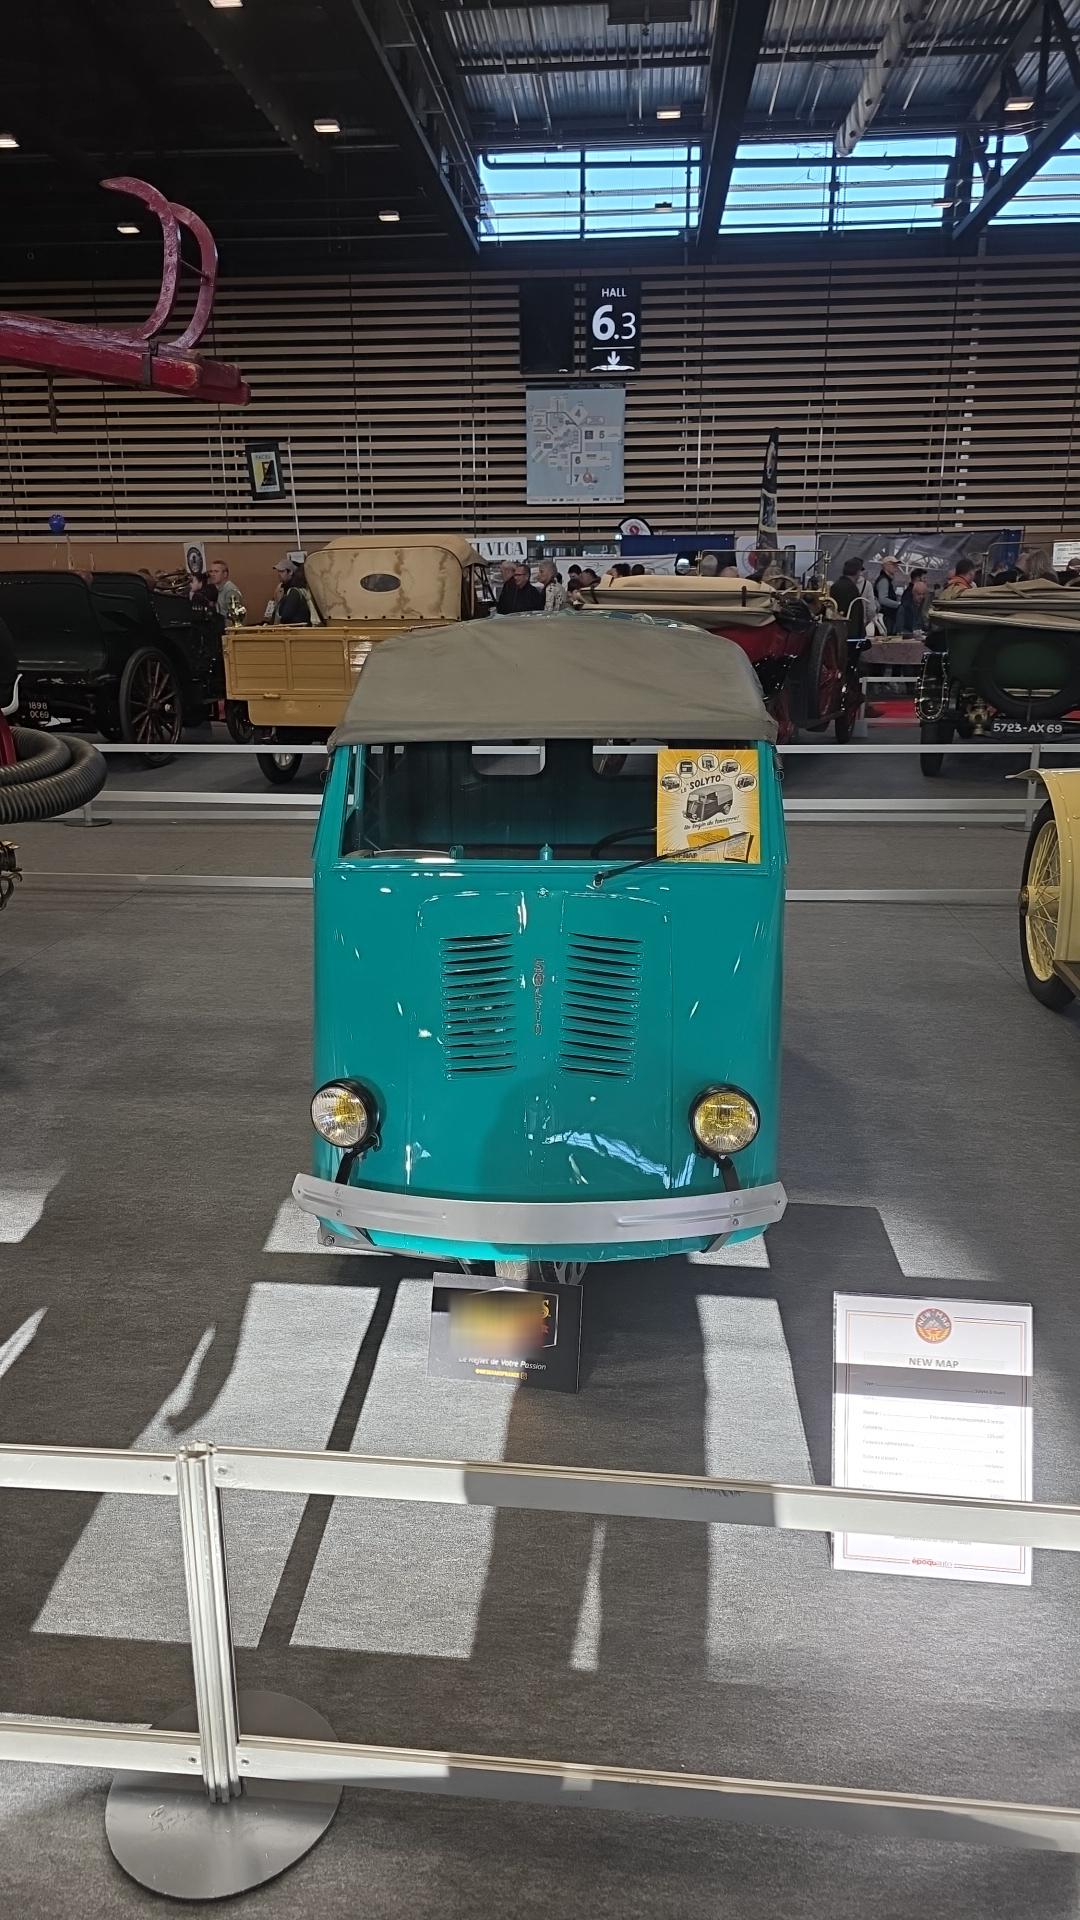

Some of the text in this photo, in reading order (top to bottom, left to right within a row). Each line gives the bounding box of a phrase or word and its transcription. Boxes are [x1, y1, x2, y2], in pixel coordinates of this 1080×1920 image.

[601, 288, 627, 298] HALL
[592, 304, 636, 341] 6.3
[28, 701, 48, 710] 1898
[917, 1311, 951, 1328] NEW MAP
[519, 1360, 547, 1370] Passion
[908, 1357, 960, 1369] NEW MAP
